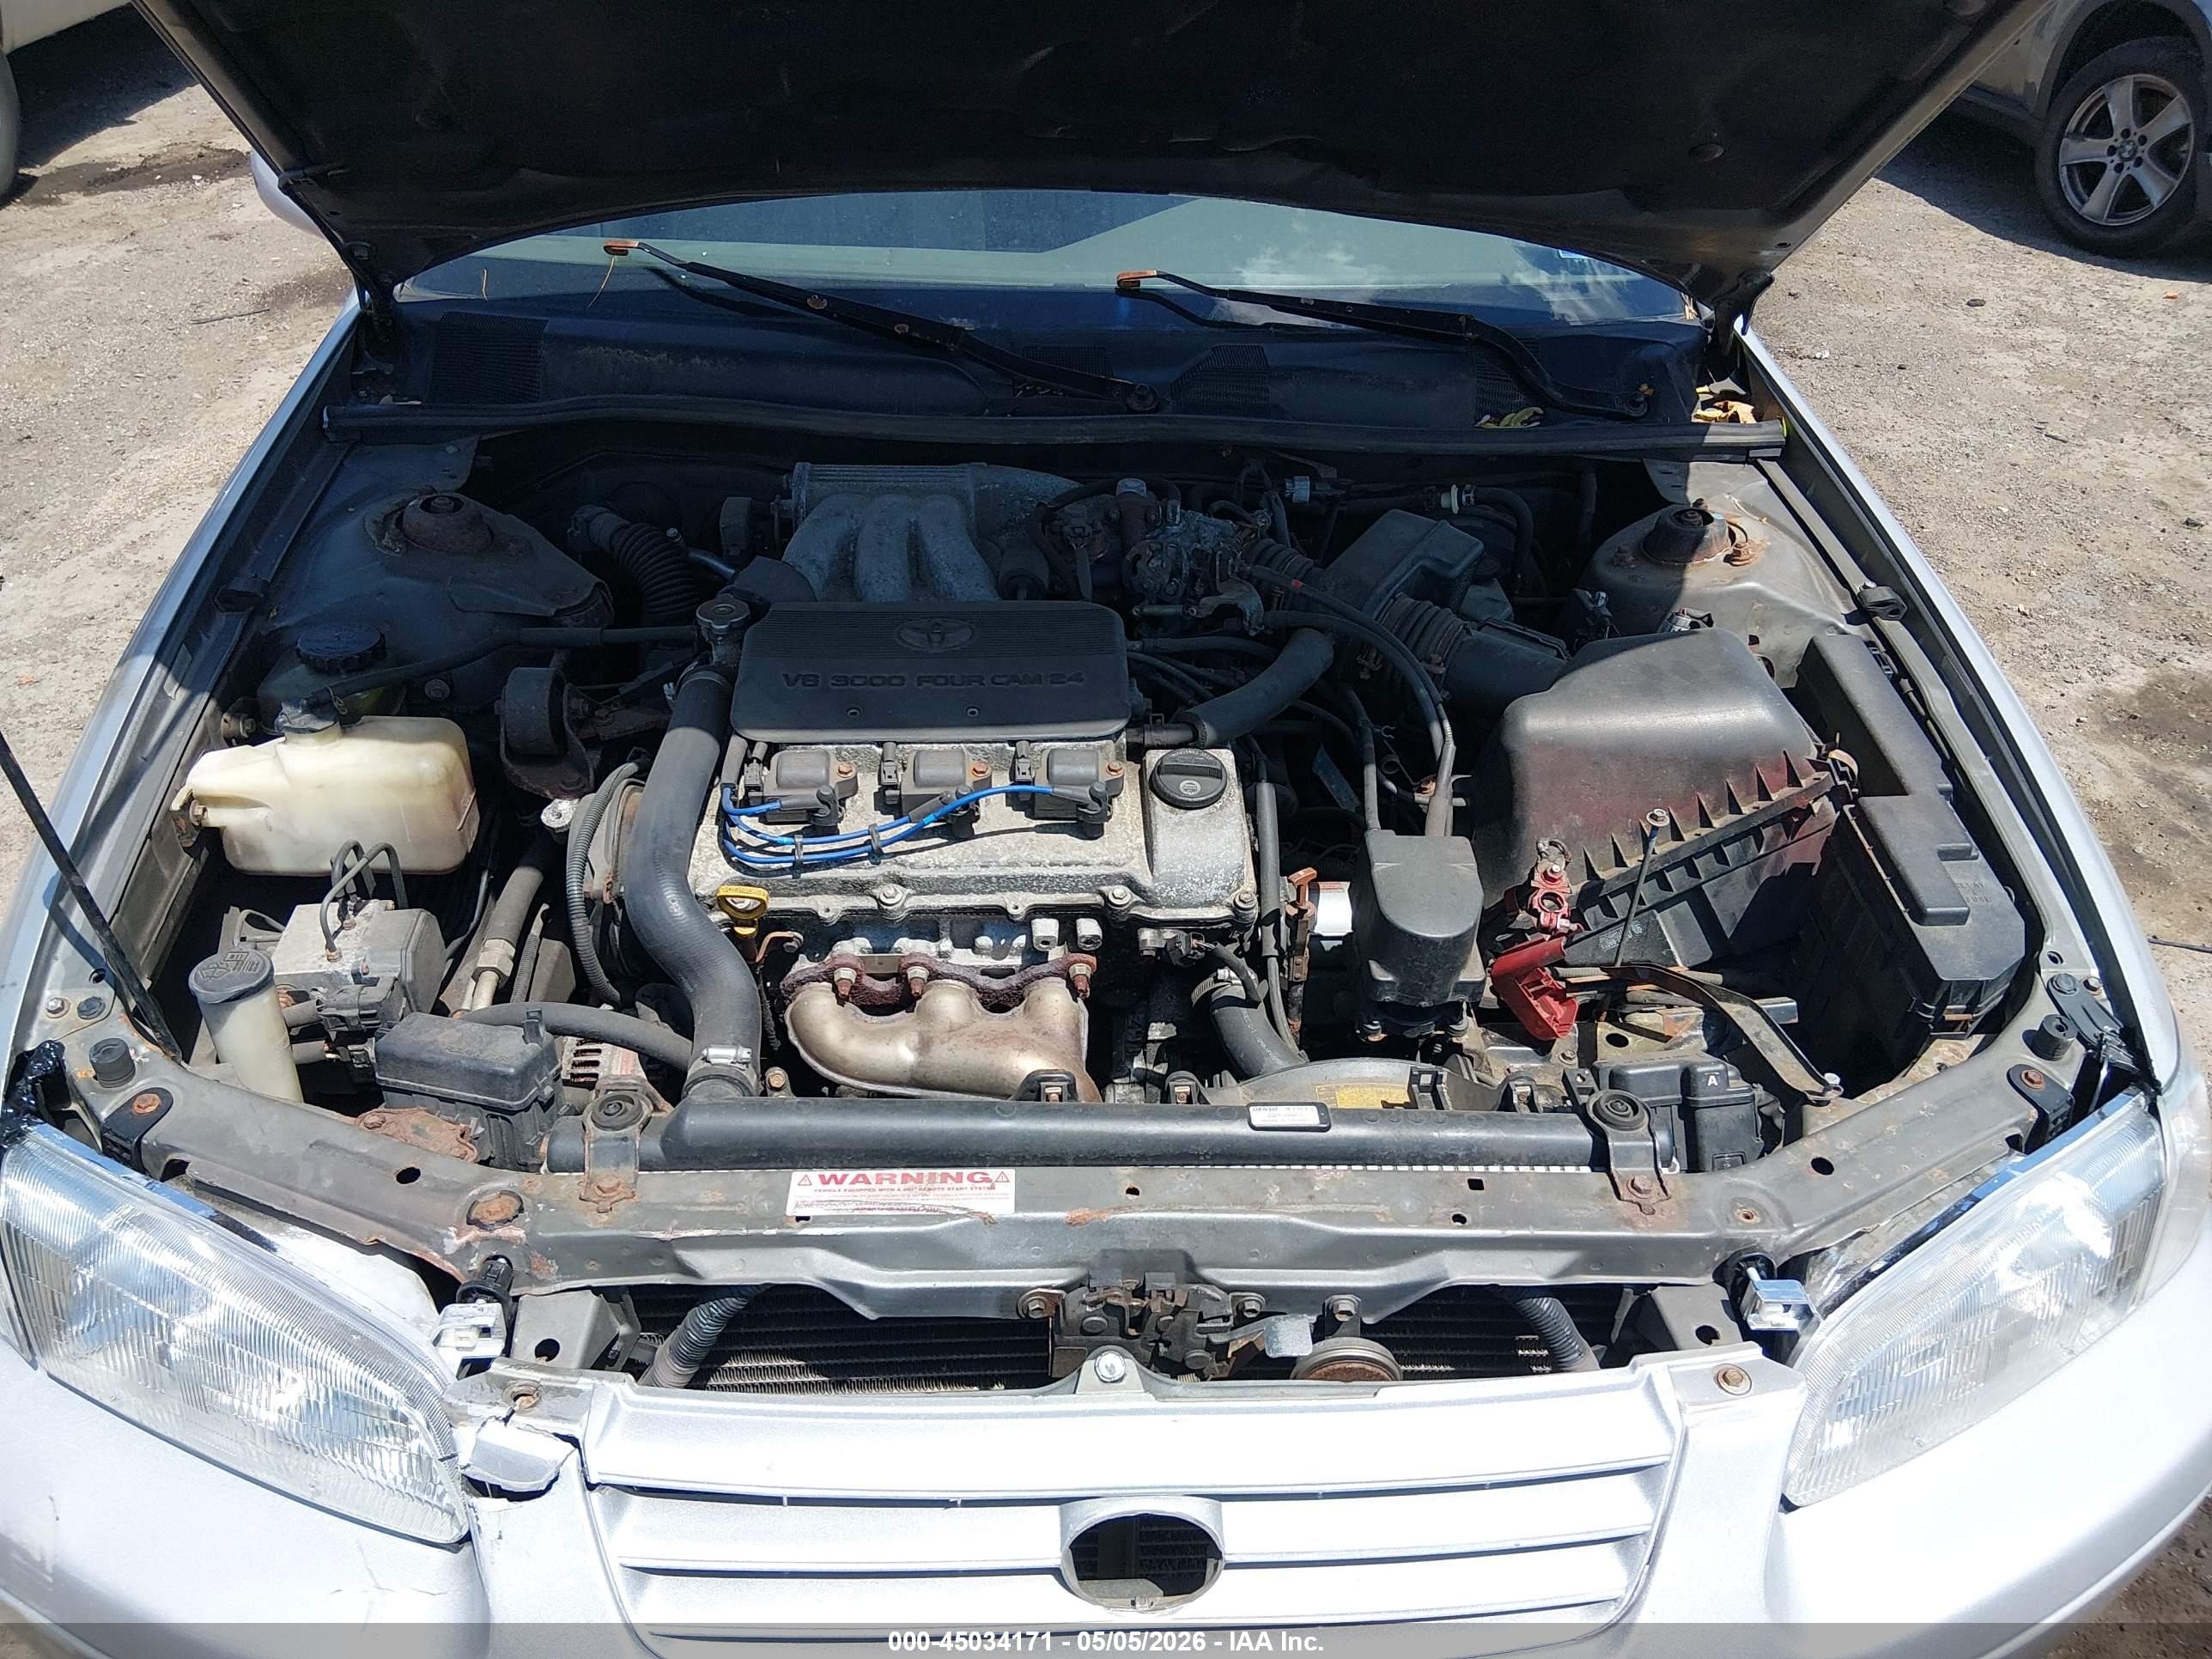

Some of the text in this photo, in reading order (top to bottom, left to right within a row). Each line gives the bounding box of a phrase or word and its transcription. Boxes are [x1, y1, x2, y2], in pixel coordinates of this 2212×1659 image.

[782, 672, 1085, 687] V6 3000 FOUR CAM 24
[1707, 1075, 1718, 1086] A
[818, 1171, 994, 1186] WARNING
